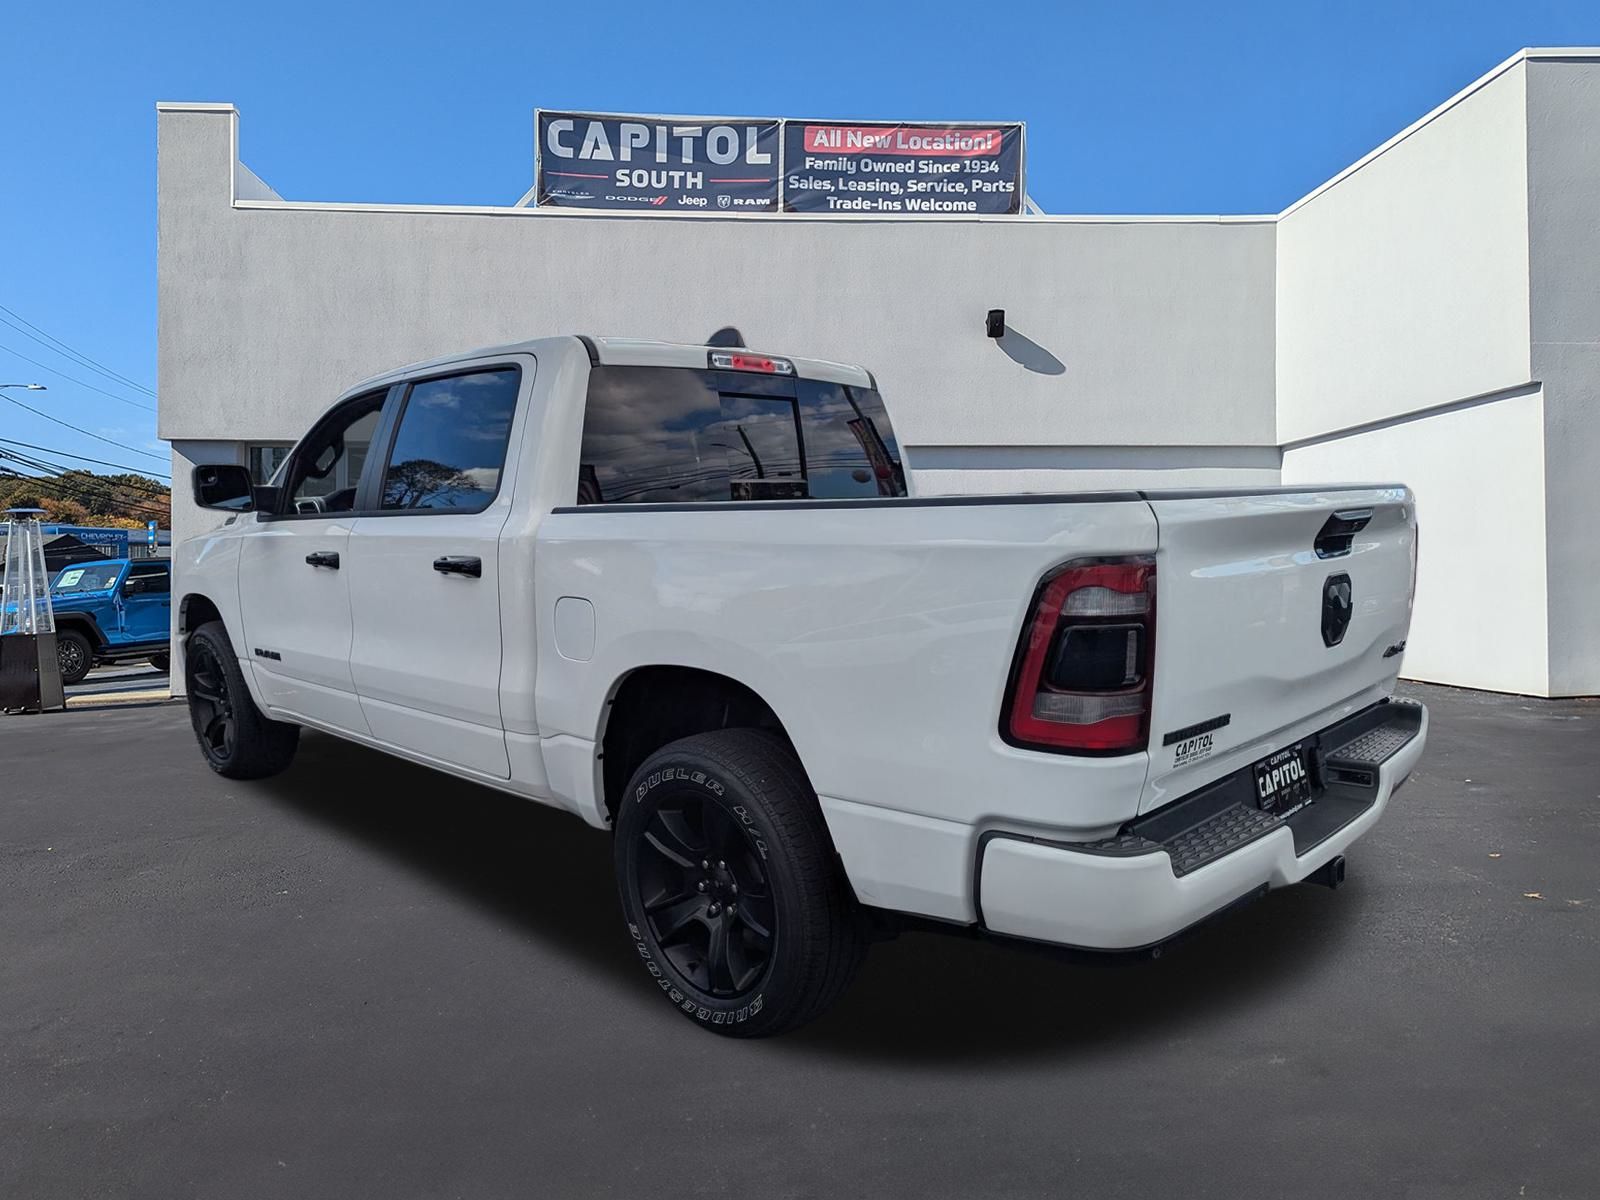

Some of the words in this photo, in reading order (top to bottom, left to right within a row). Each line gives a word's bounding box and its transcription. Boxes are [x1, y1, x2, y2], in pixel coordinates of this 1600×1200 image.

[547, 119, 772, 165] CAPITOL
[813, 129, 841, 148] All
[847, 131, 892, 149] New
[897, 132, 993, 151] Location!
[805, 157, 857, 174] Family
[860, 158, 915, 173] Owned
[918, 159, 960, 174] Since
[963, 160, 1000, 174] 1934
[615, 168, 703, 190] SOUTH
[789, 175, 835, 192] Sales,
[838, 178, 904, 195] Leasing,
[907, 179, 969, 195] Service,
[972, 179, 1015, 193] Parts
[678, 195, 708, 207] Jeep
[827, 196, 901, 211] Trade-Ins
[905, 198, 977, 211] Welcome
[1175, 733, 1213, 757] CAPITOL
[635, 768, 725, 803] DUELER
[1258, 758, 1306, 797] CAPITOL
[628, 922, 763, 1024] BRIDGESTONE
